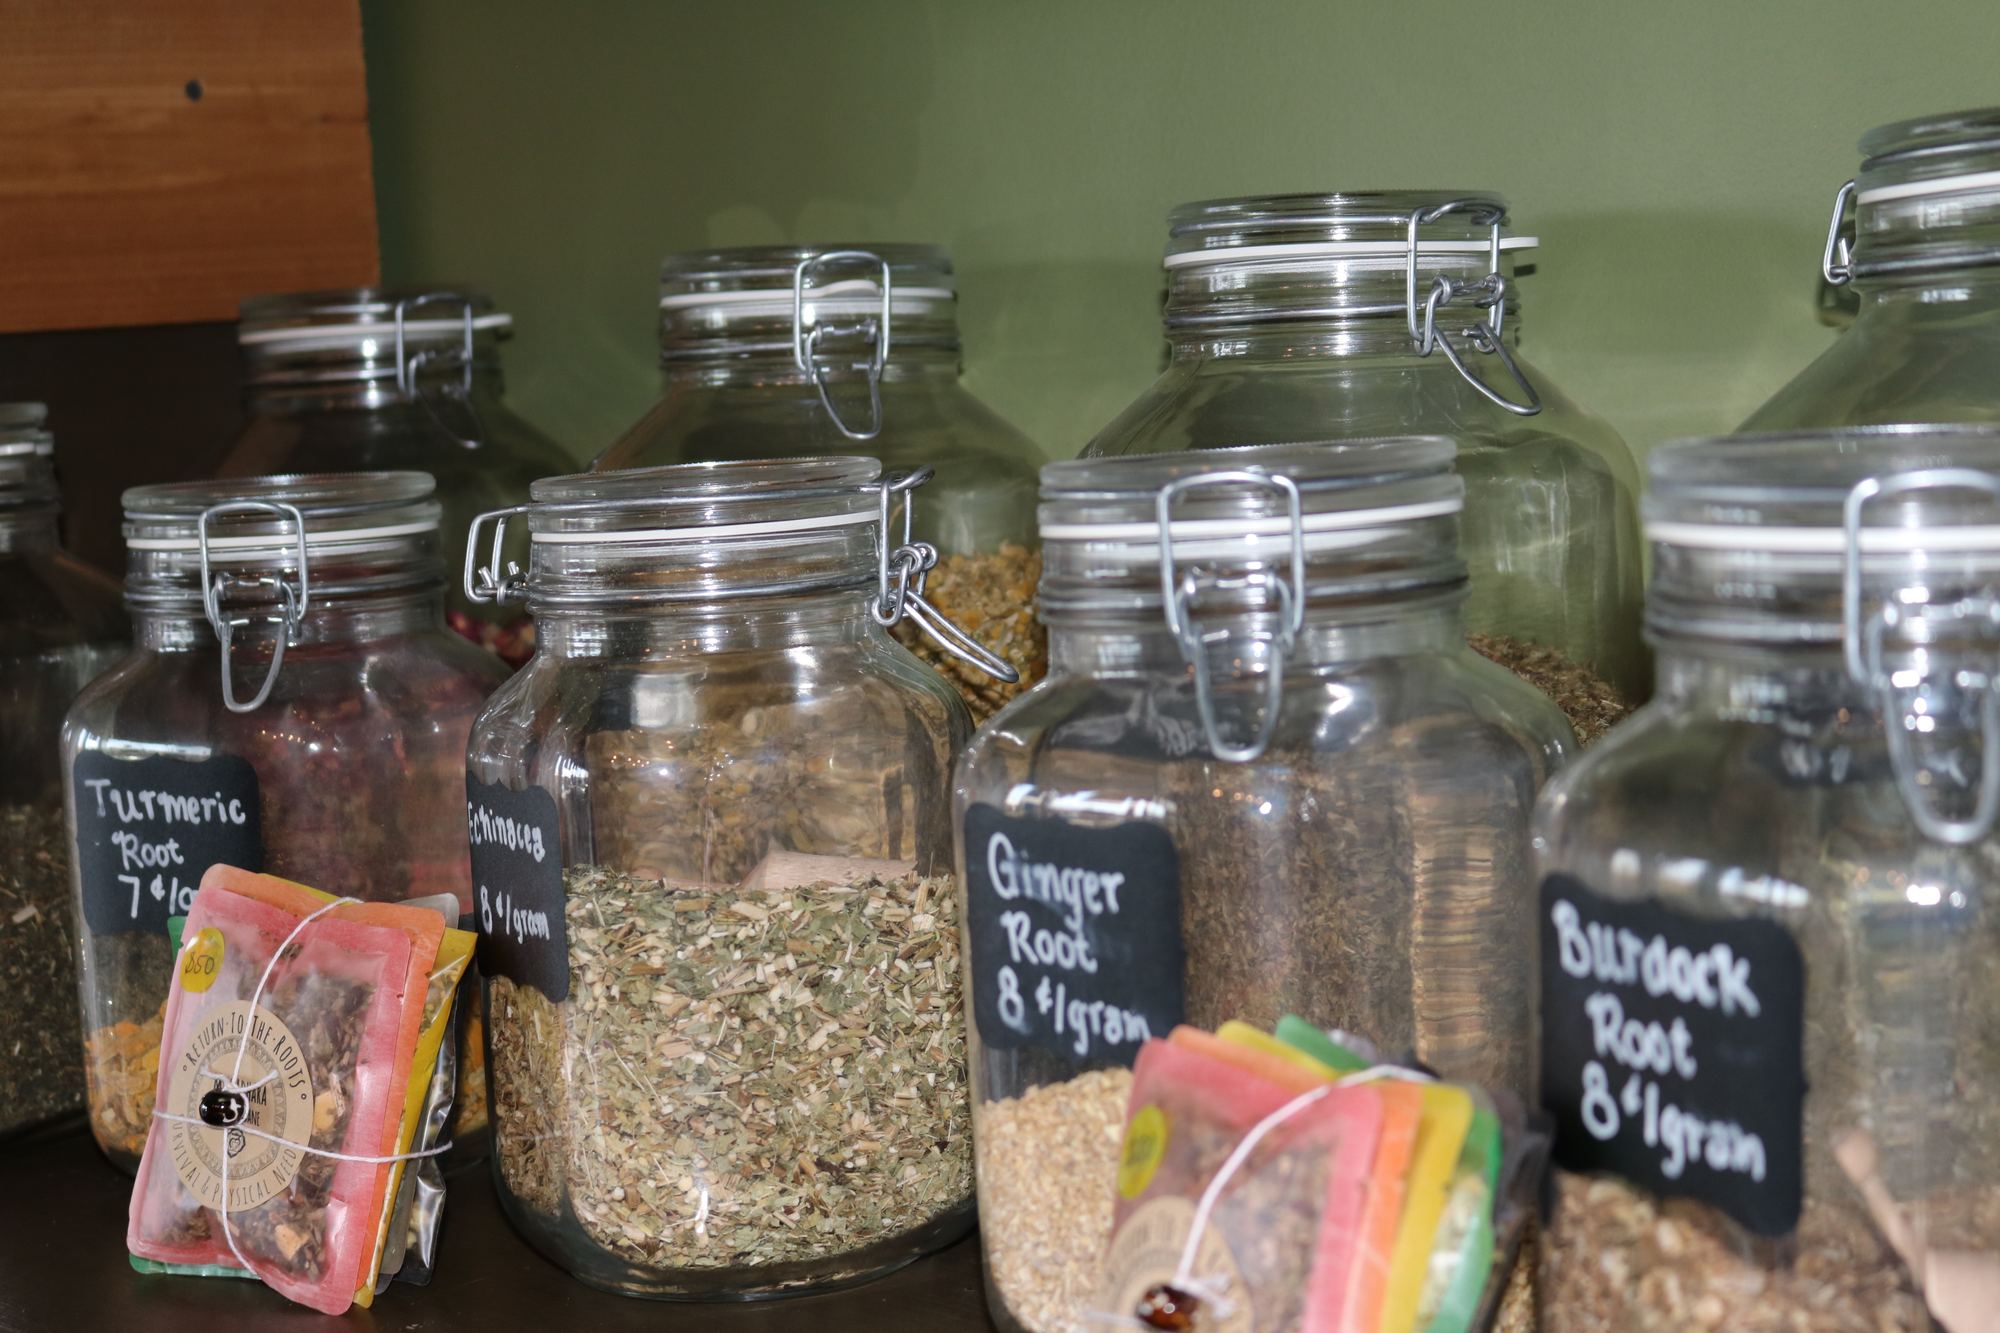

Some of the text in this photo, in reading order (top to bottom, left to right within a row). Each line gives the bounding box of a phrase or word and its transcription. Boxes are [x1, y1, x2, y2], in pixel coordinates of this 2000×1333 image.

[84, 778, 246, 825] Turmeric
[467, 801, 546, 863] Echinacea
[111, 830, 184, 871] Root
[987, 831, 1125, 931] Ginger
[1000, 910, 1098, 974] Root
[1551, 898, 1761, 1018] Burdock
[186, 1011, 306, 1089] RETURN TO THE ROOTS
[1585, 991, 1697, 1080] Root
[172, 1113, 201, 1188] URVIVAL
[272, 1141, 299, 1186] NEED
